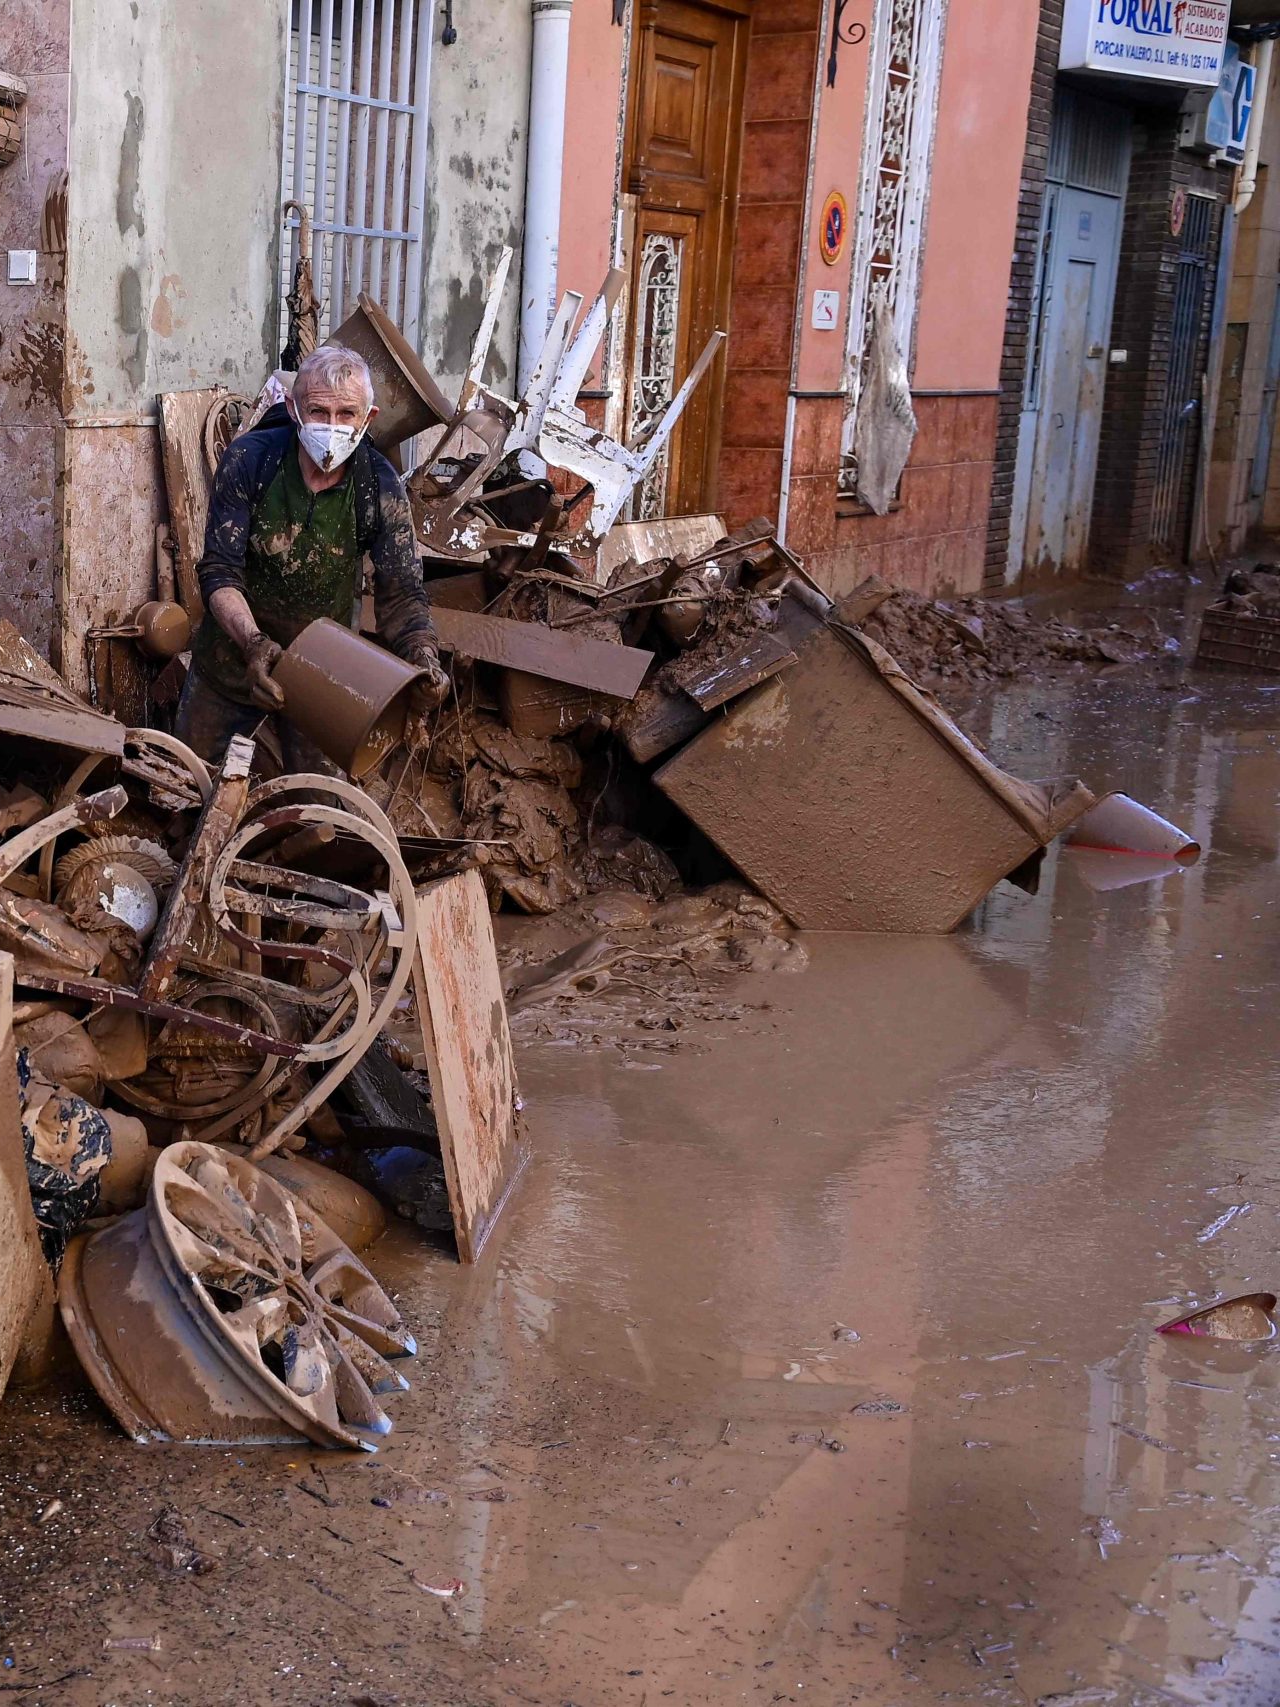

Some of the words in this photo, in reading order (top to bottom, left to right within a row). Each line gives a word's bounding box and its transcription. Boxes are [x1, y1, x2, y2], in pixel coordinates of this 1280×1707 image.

[1098, 0, 1173, 35] PORVAL
[1187, 4, 1216, 20] SISTEMAS
[1217, 10, 1226, 22] de
[1185, 22, 1223, 39] ACABADOS
[1094, 40, 1124, 57] PORCAR
[1181, 53, 1189, 67] 96
[1191, 54, 1201, 69] 125
[1202, 56, 1218, 70] 1744
